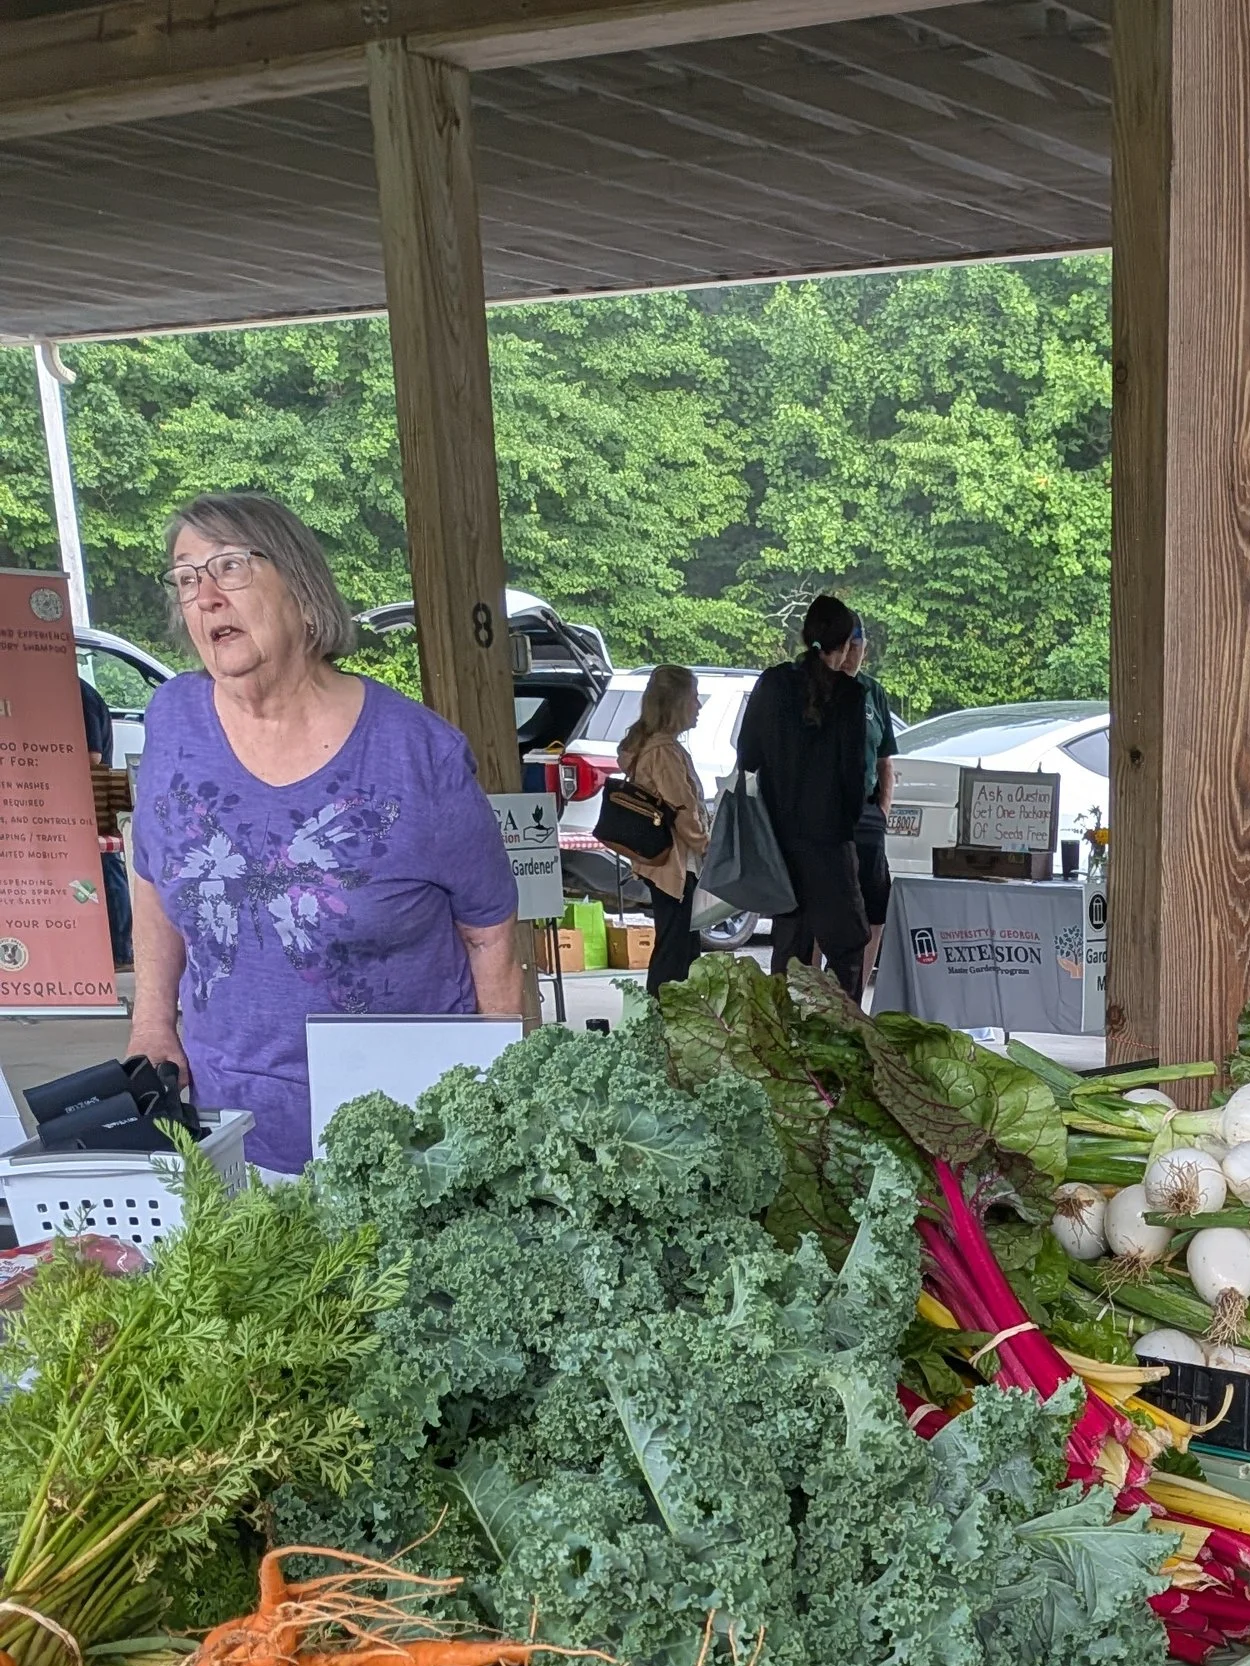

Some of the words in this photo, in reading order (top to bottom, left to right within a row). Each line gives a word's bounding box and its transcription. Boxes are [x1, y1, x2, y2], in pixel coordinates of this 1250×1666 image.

[471, 601, 494, 650] 8
[22, 742, 74, 754] POWDER
[10, 757, 39, 768] FOR:
[16, 782, 50, 791] WASHES
[977, 784, 1004, 801] Ask
[1014, 785, 1051, 804] Question
[3, 798, 45, 808] REQUIRED
[972, 802, 993, 820] Get
[995, 804, 1016, 820] One
[10, 816, 29, 825] AND
[32, 816, 77, 826] CONTROLS
[972, 822, 988, 841] Of
[994, 823, 1024, 841] Seeds
[1026, 825, 1048, 842] Free
[36, 834, 67, 843] TRAVEL
[28, 851, 69, 861] MOBILITY
[5, 919, 40, 930] YOUR
[45, 919, 77, 930] DOG!
[940, 929, 989, 940] UNIVERSITY
[999, 929, 1041, 941] GEORGIA
[1, 981, 114, 998] SYSQRL.COM
